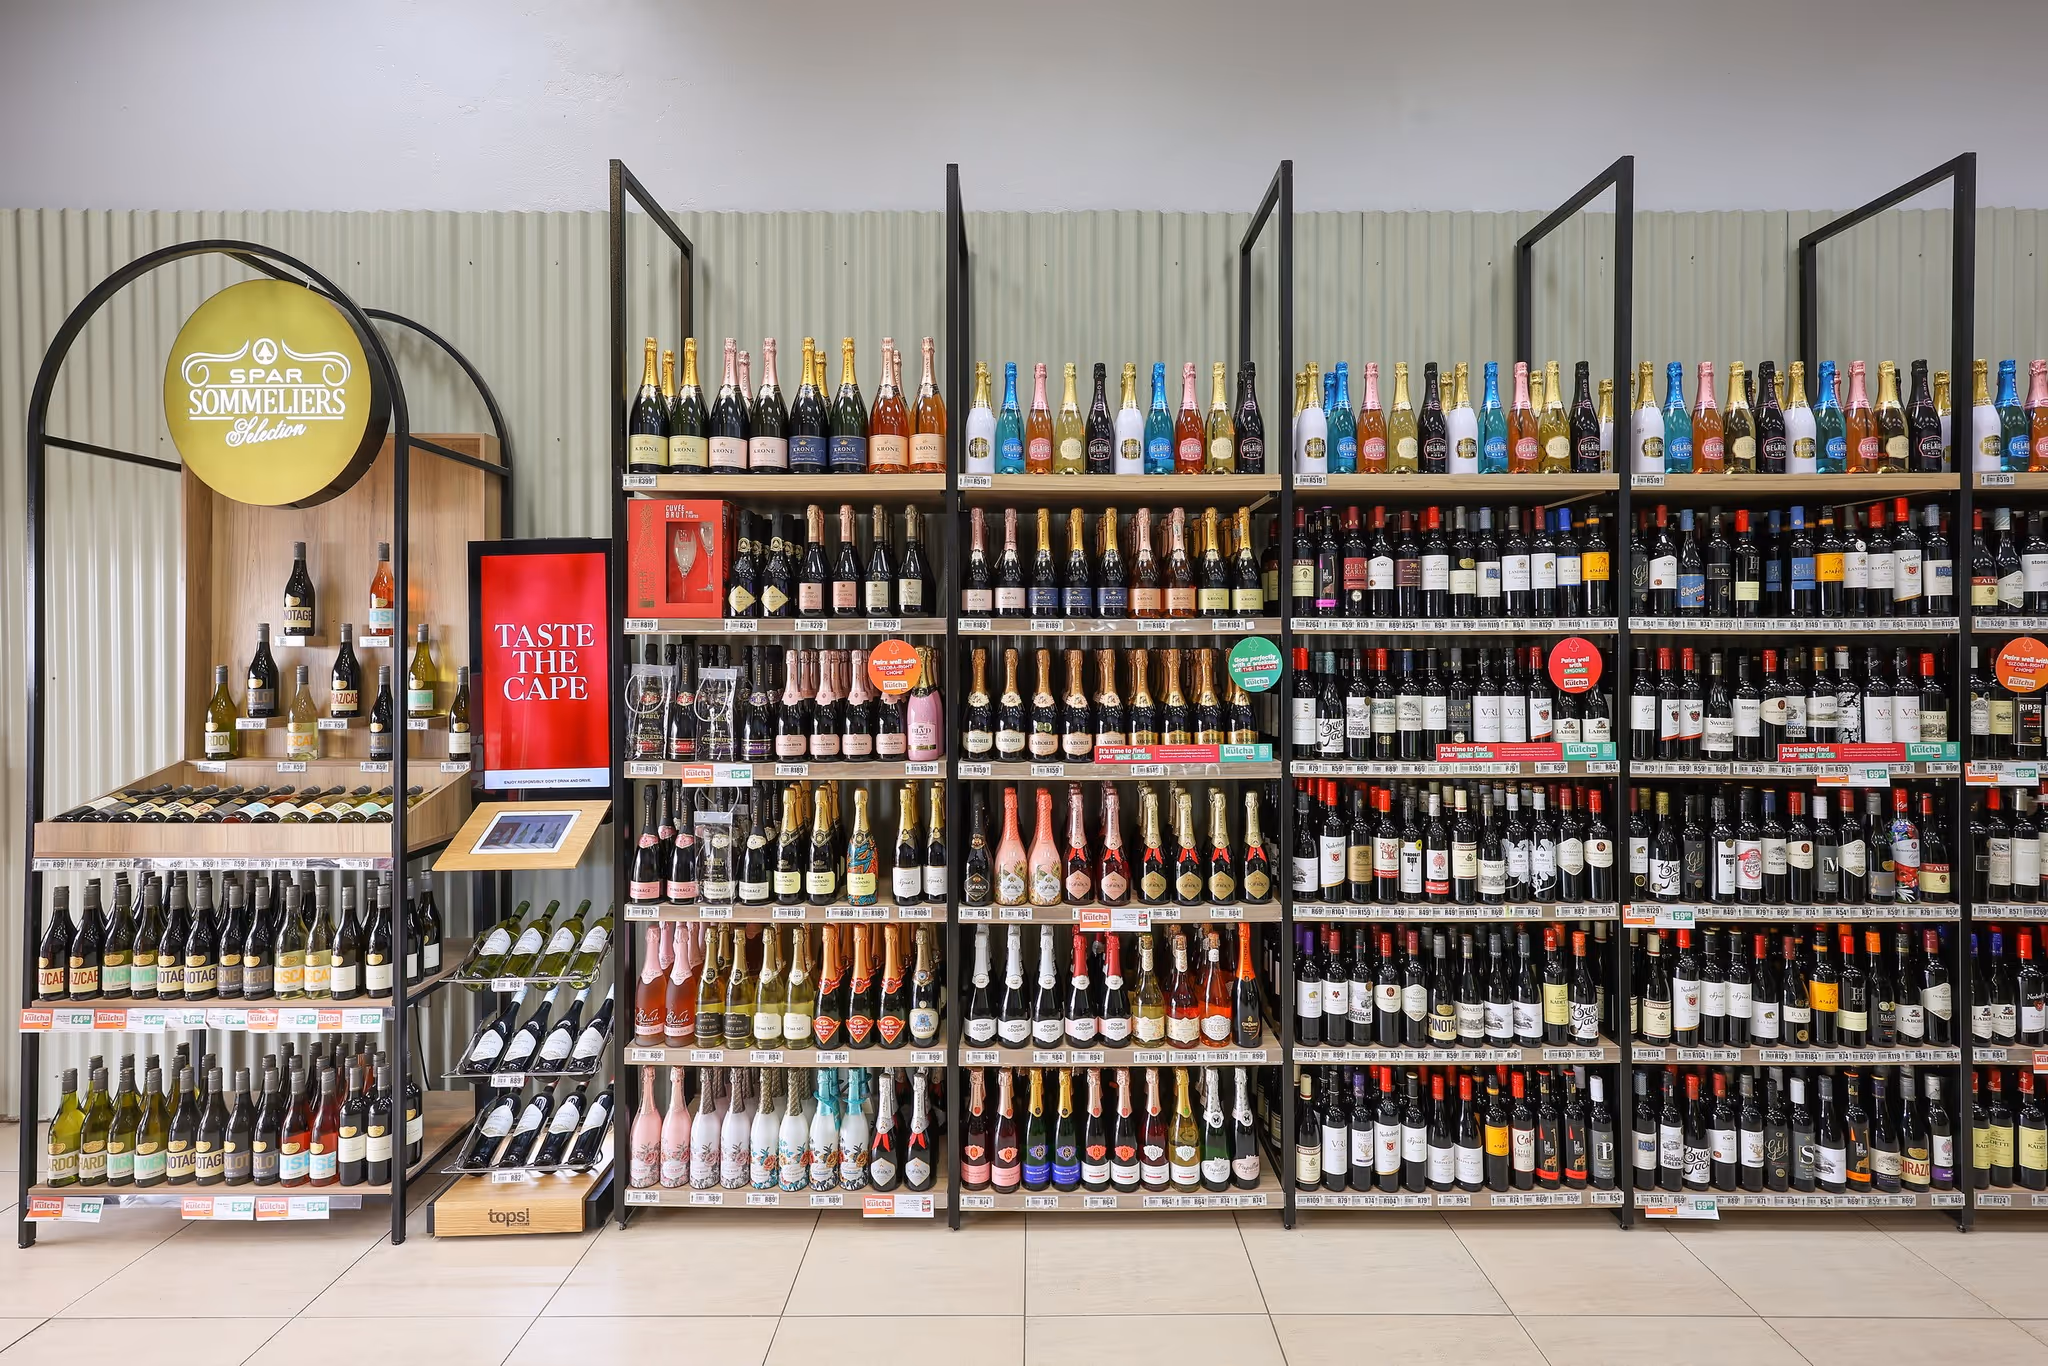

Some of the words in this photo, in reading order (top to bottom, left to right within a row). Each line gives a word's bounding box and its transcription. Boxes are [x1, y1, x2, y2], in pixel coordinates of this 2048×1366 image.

[230, 368, 302, 384] SPAR
[188, 388, 346, 415] SOMMELIERS
[225, 416, 306, 448] Selection
[494, 624, 595, 648] TASTE
[512, 650, 578, 674] THE
[503, 676, 588, 701] CAPE
[488, 1208, 529, 1227] tops!
